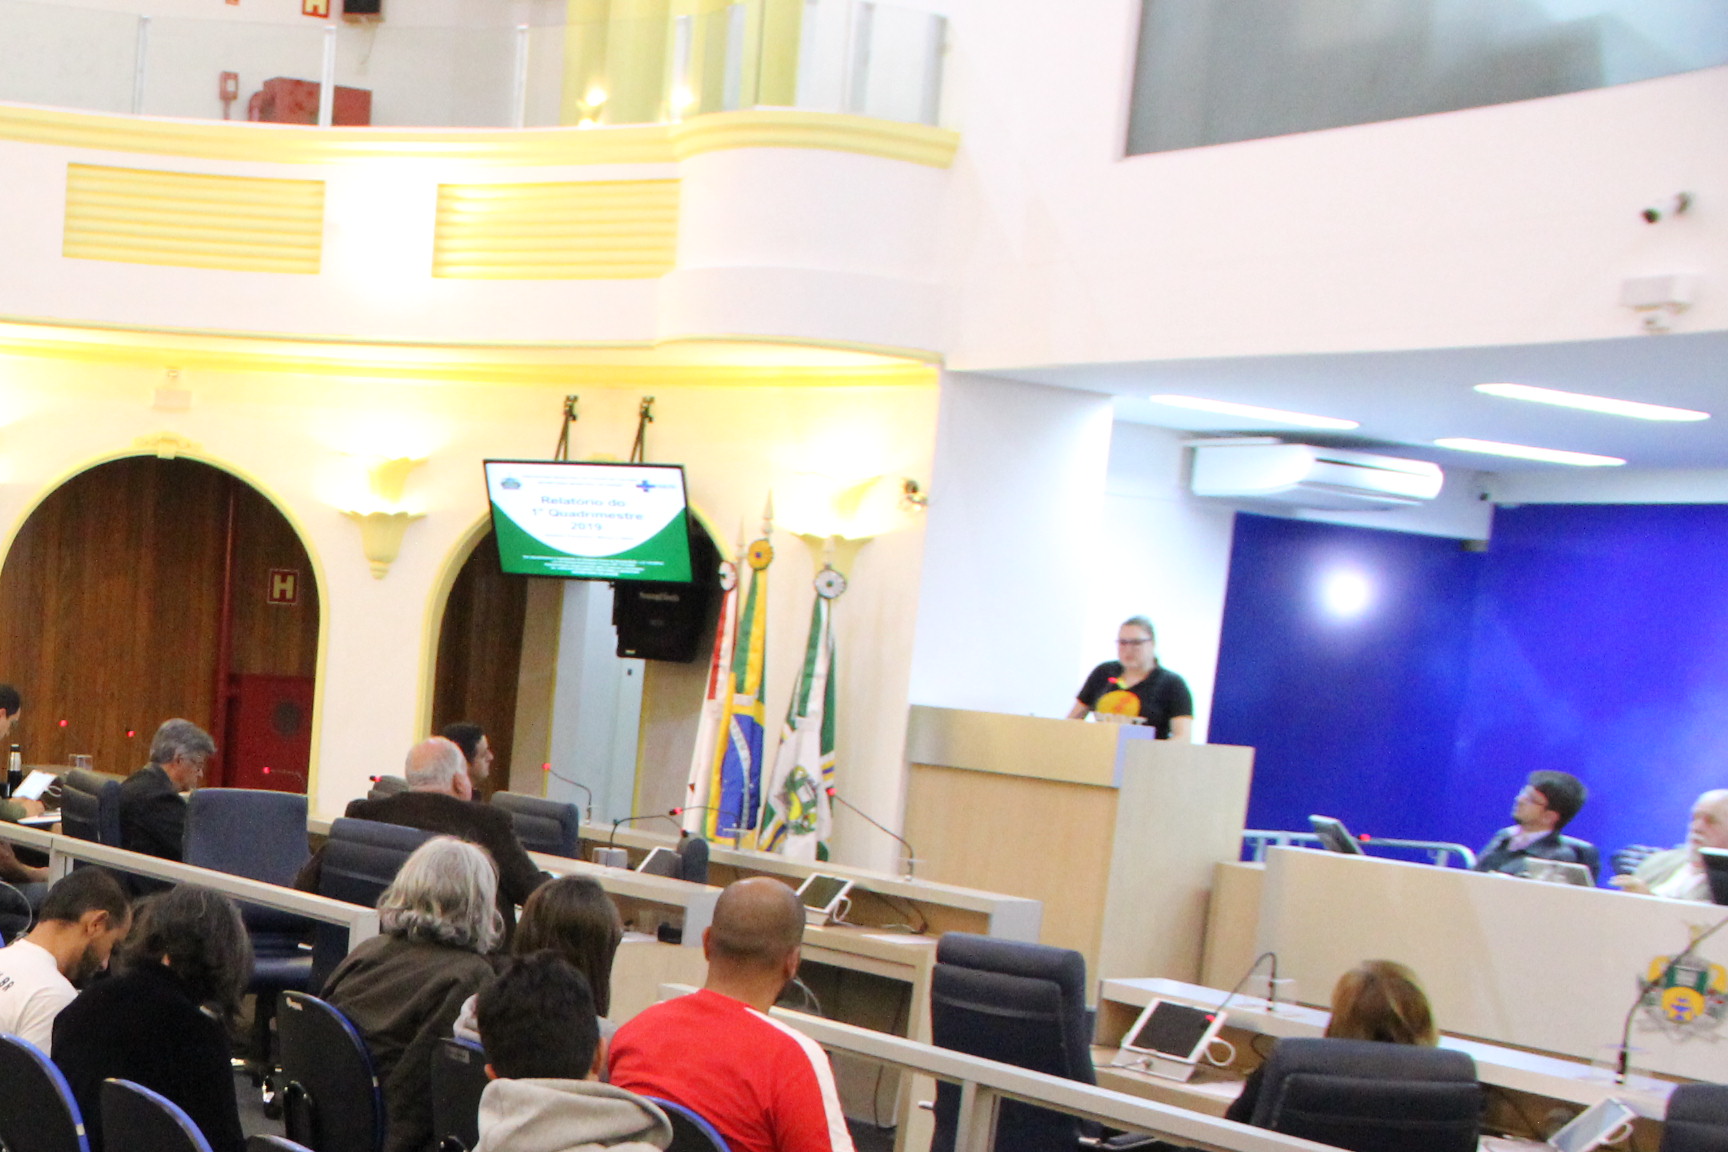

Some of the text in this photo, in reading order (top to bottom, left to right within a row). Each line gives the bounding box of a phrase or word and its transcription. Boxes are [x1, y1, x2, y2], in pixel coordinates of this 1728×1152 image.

[541, 495, 603, 506] Relatório
[548, 508, 644, 520] Quadrimestre
[571, 521, 603, 531] 2019
